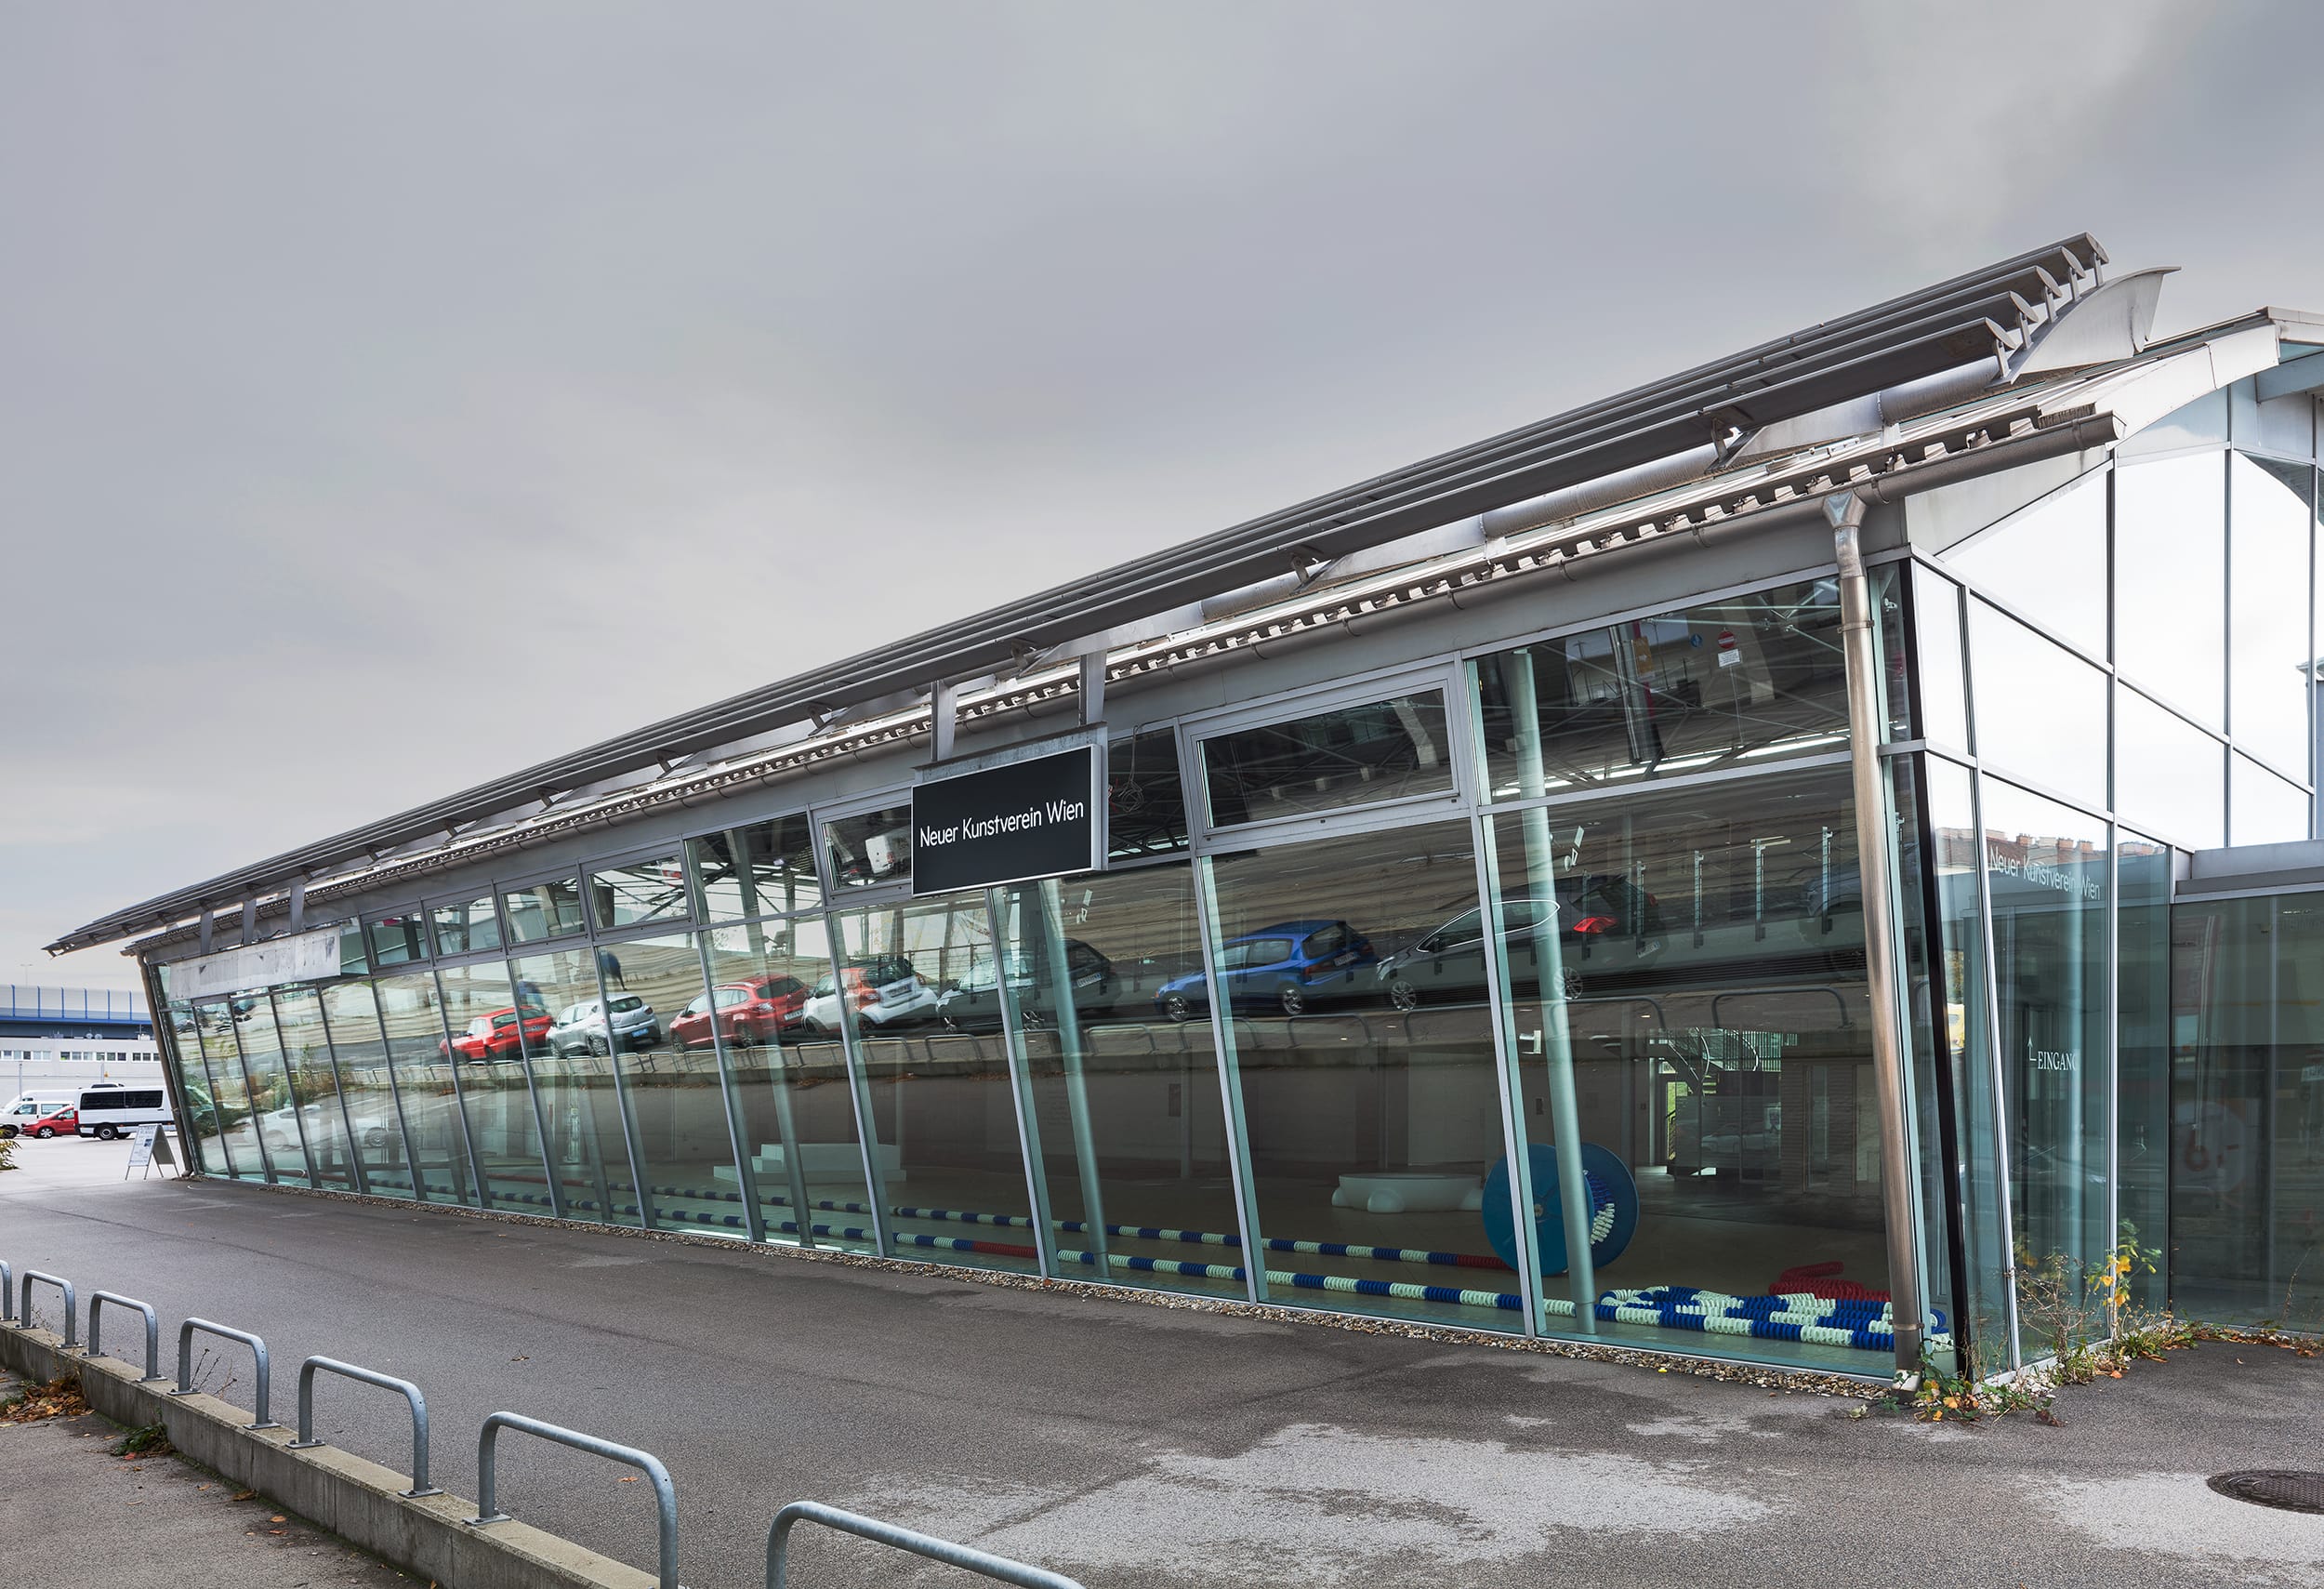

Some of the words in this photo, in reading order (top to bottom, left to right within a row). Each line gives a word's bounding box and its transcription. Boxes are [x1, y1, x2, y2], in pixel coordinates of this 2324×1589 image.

[919, 825, 958, 848] Neuer
[962, 807, 1041, 840] Kunstverein
[1046, 799, 1084, 824] Wien
[1989, 846, 2020, 877] Neuer
[2023, 854, 2076, 893] Kunstverein
